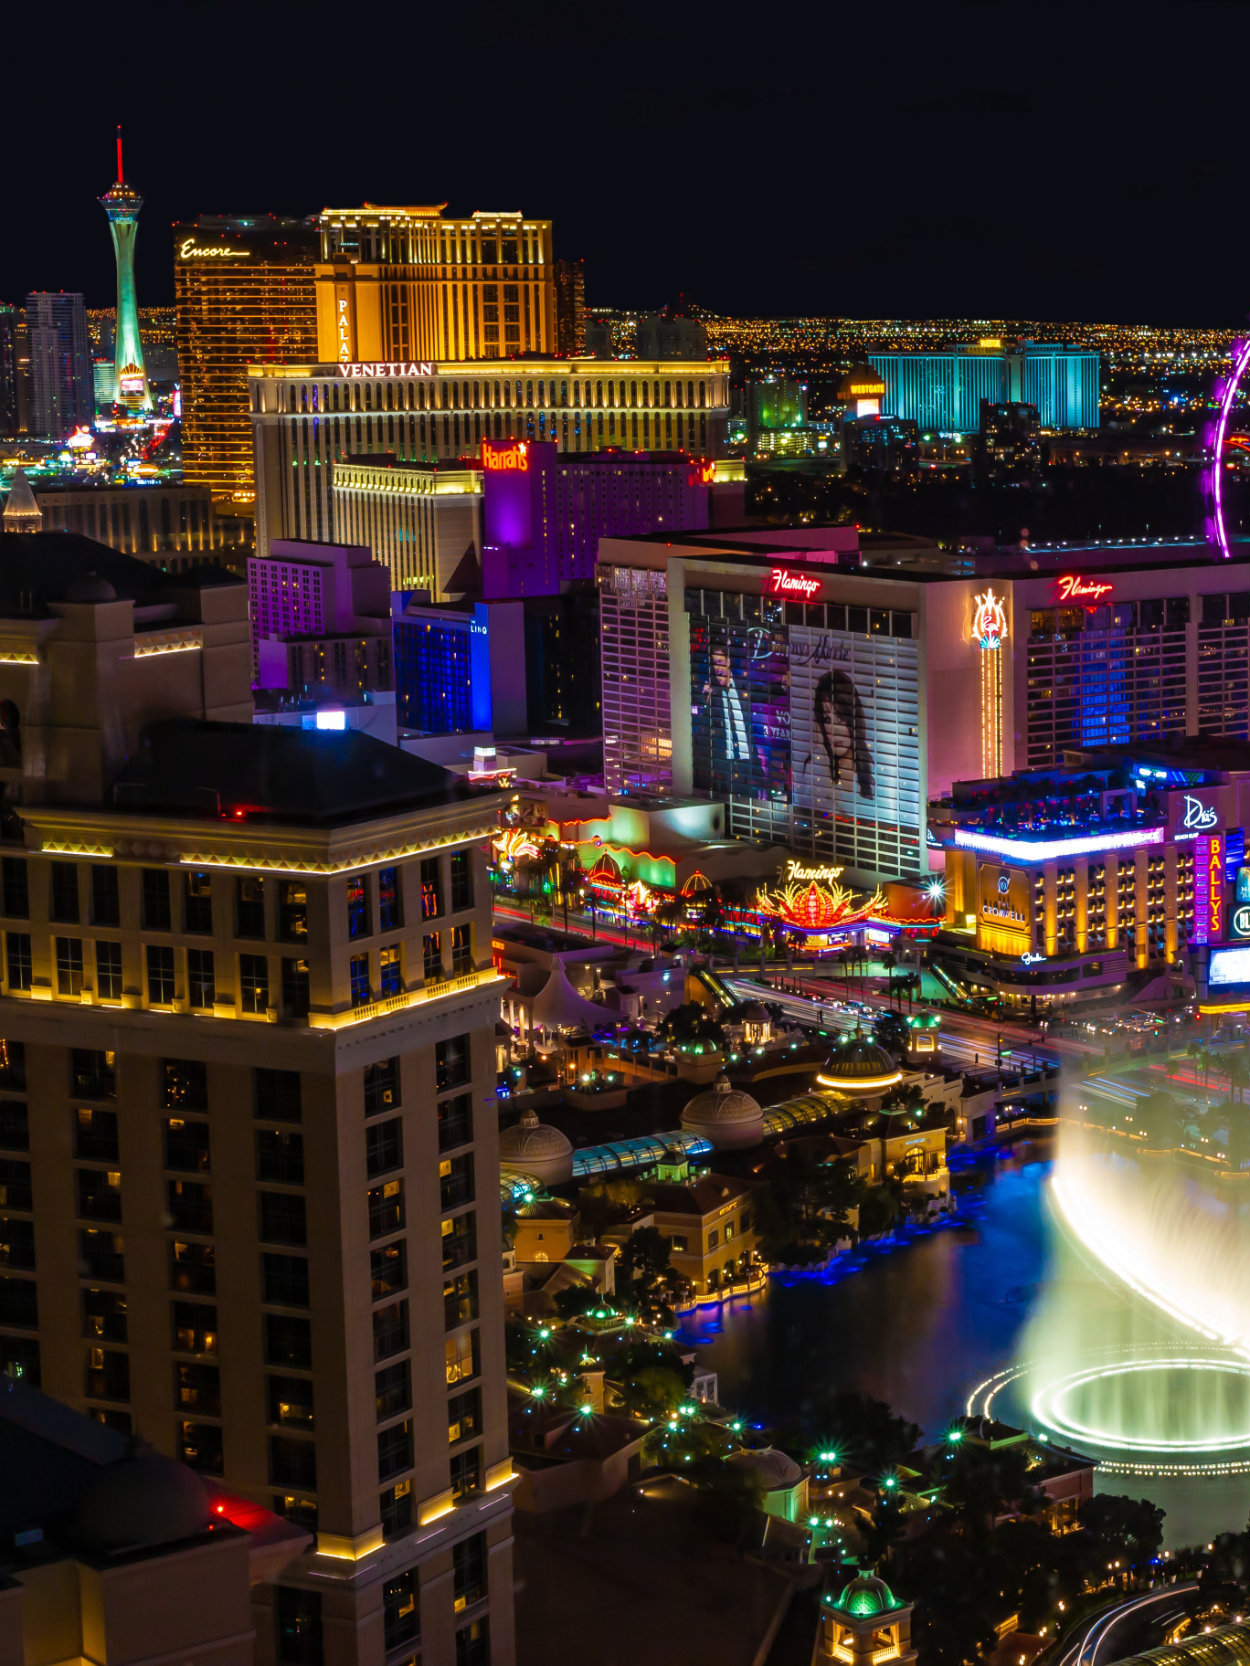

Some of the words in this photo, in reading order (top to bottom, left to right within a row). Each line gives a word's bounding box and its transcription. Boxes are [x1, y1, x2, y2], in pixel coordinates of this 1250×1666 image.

[180, 238, 249, 259] Encore
[337, 362, 432, 377] VENETIAN
[772, 569, 820, 598] Flamingo
[1058, 576, 1112, 600] Flamingo
[787, 860, 844, 884] Flamingo
[1209, 839, 1221, 931] BALLYS
[983, 905, 1025, 923] CROMWELL
